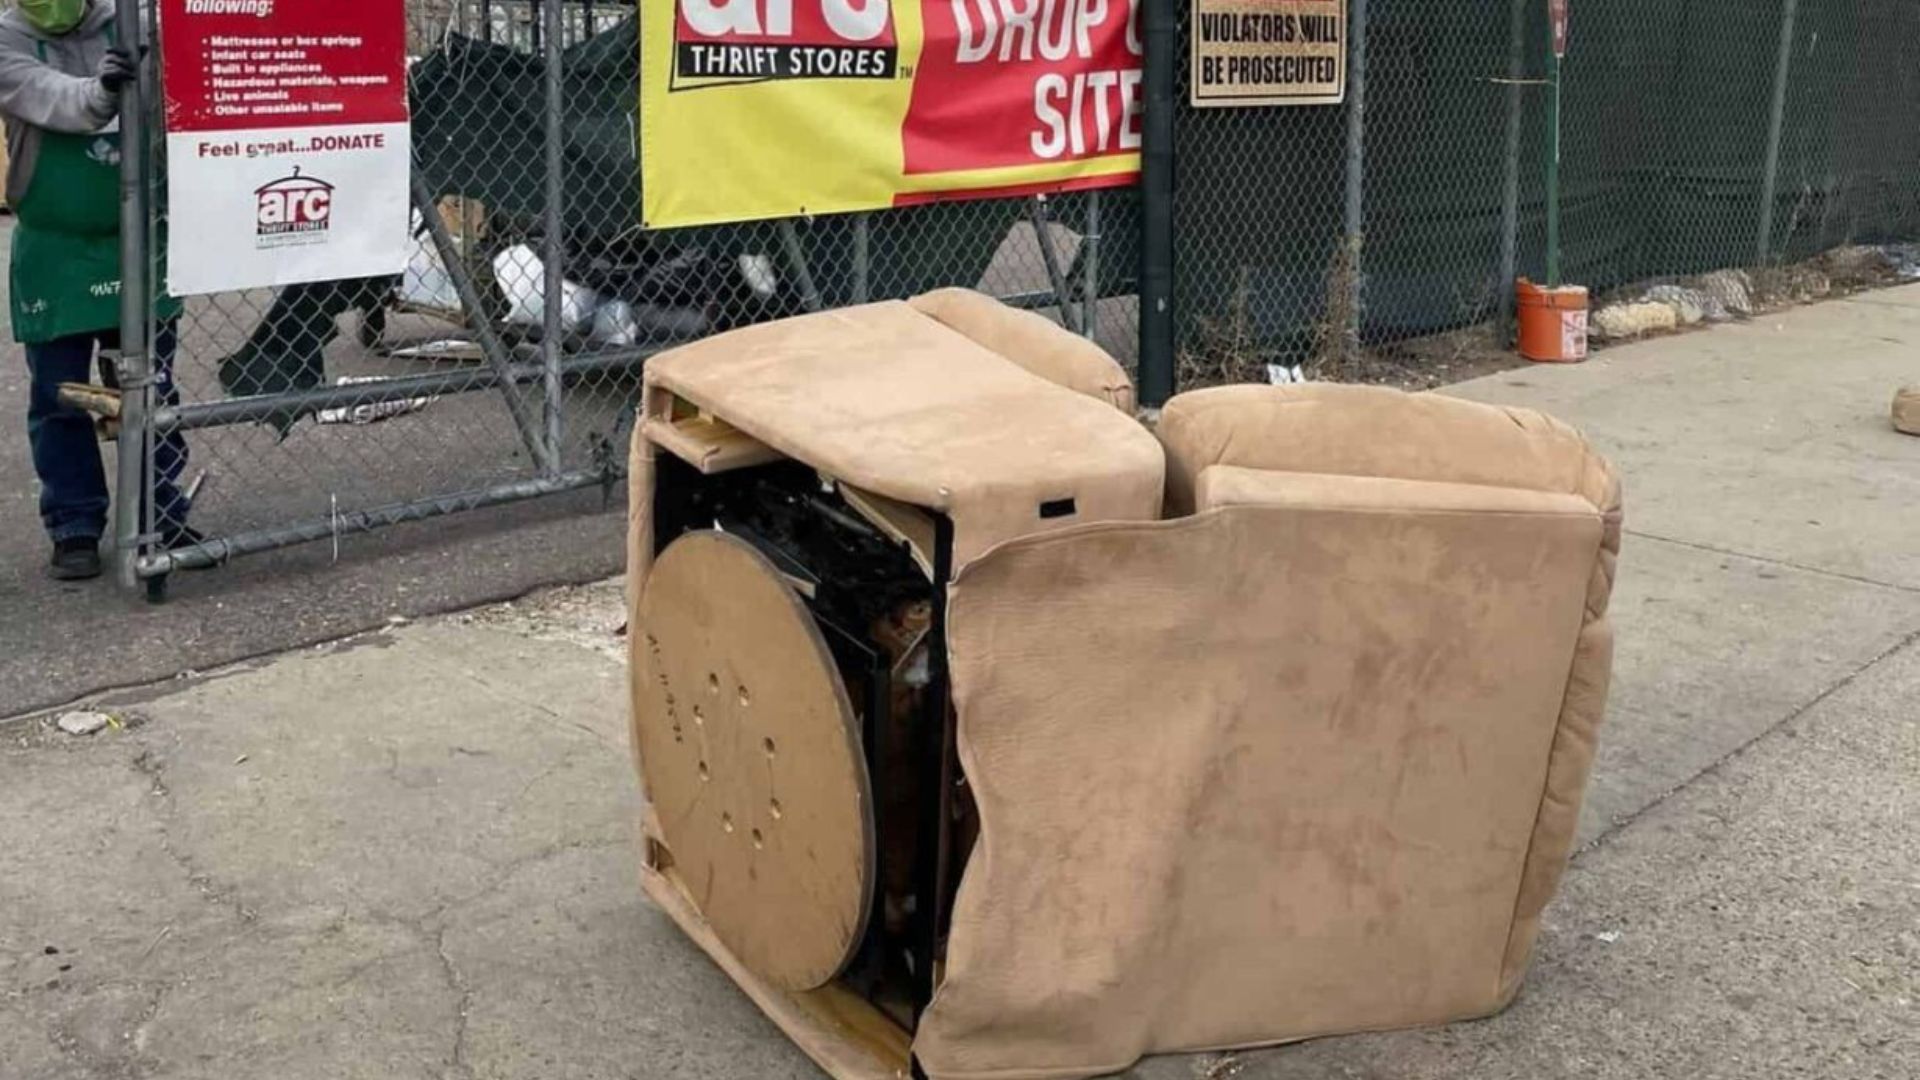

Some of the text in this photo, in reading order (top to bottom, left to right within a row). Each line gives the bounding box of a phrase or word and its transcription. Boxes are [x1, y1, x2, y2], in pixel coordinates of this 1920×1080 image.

[281, 37, 294, 46] or
[952, 0, 1108, 63] DROP
[1201, 13, 1337, 43] VIOLATORS WILL
[691, 46, 886, 76] THRIFT STORES
[1202, 55, 1335, 84] BE PROSECUTED
[1031, 69, 1143, 158] SITE
[199, 142, 239, 158] Feel
[260, 189, 329, 224] arc
